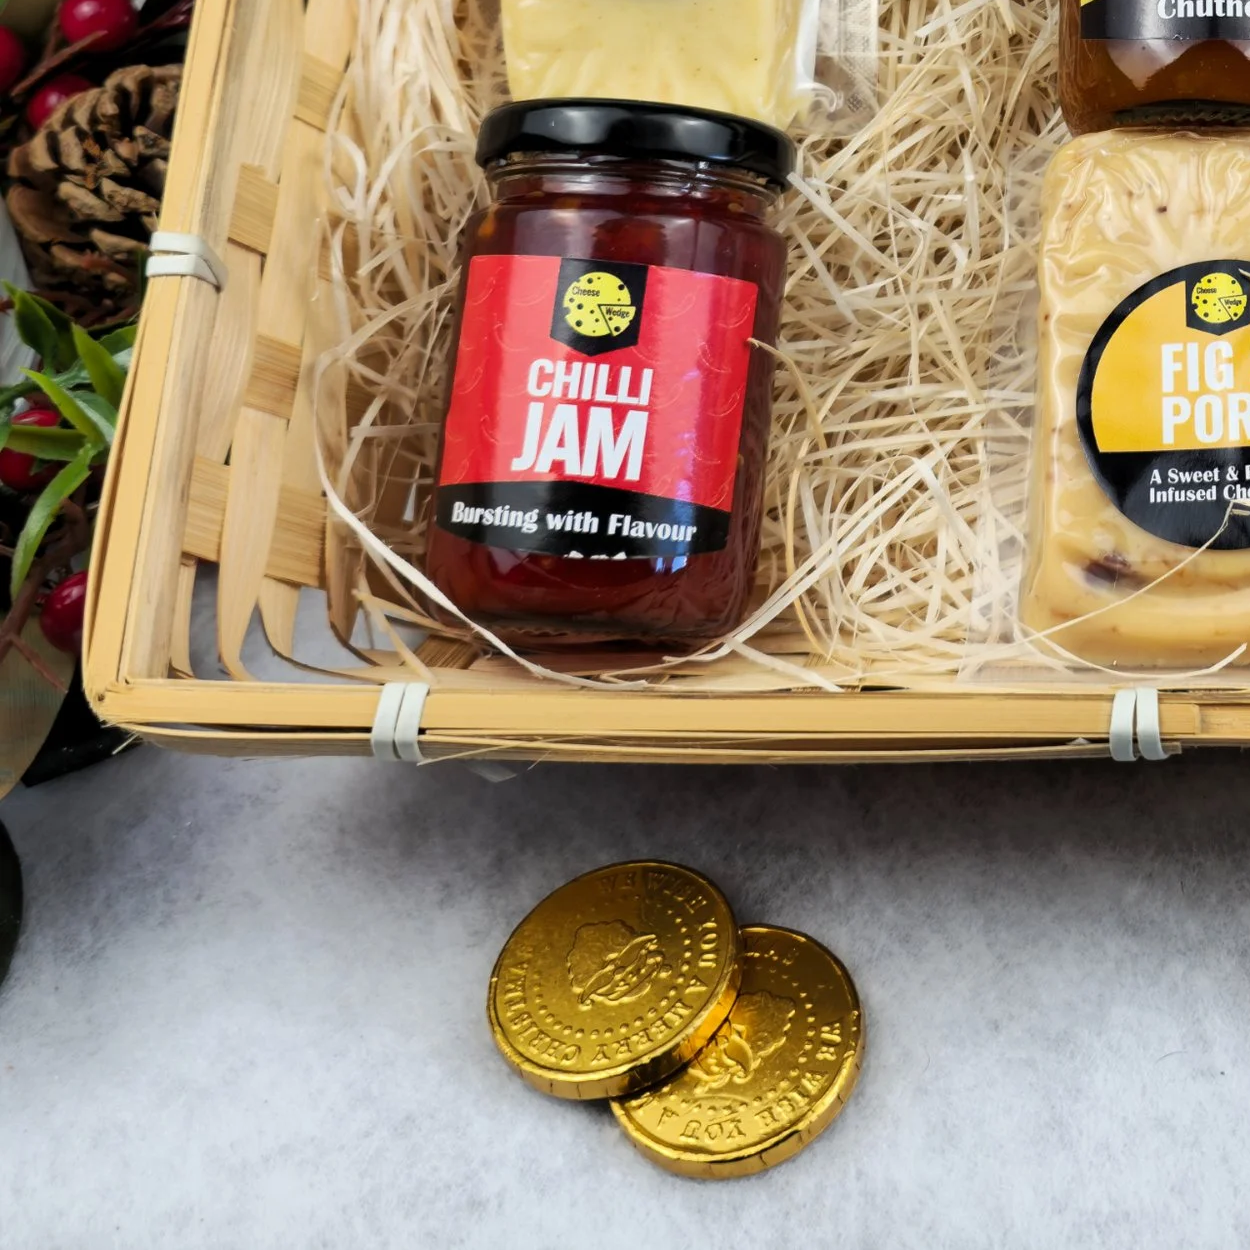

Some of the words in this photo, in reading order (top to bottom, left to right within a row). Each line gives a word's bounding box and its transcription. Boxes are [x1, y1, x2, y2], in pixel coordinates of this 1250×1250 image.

[527, 358, 654, 406] CHILLI
[1161, 340, 1234, 393] FIG
[510, 402, 649, 481] JAM
[1150, 469, 1162, 485] A
[1167, 467, 1220, 485] Sweet
[1226, 465, 1239, 481] &
[1150, 485, 1217, 503] Infused
[451, 501, 539, 533] Bursting
[546, 510, 599, 534] with
[607, 514, 698, 542] Flavour
